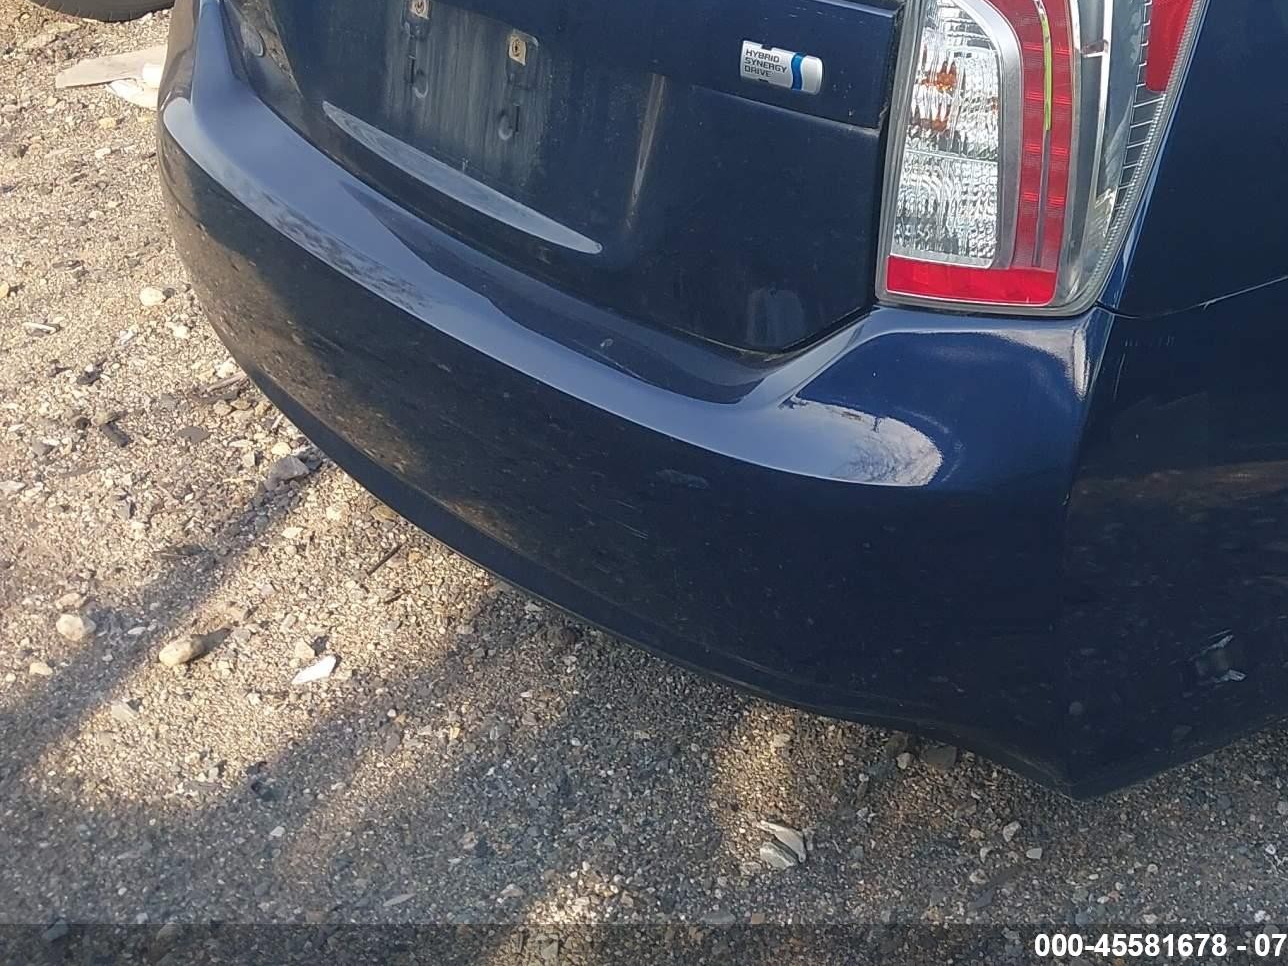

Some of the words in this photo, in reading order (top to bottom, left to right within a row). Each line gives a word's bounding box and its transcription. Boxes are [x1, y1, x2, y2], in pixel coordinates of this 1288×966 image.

[745, 48, 780, 63] HYBRID
[744, 57, 788, 73] SYNERGY
[744, 65, 773, 77] DRIVE
